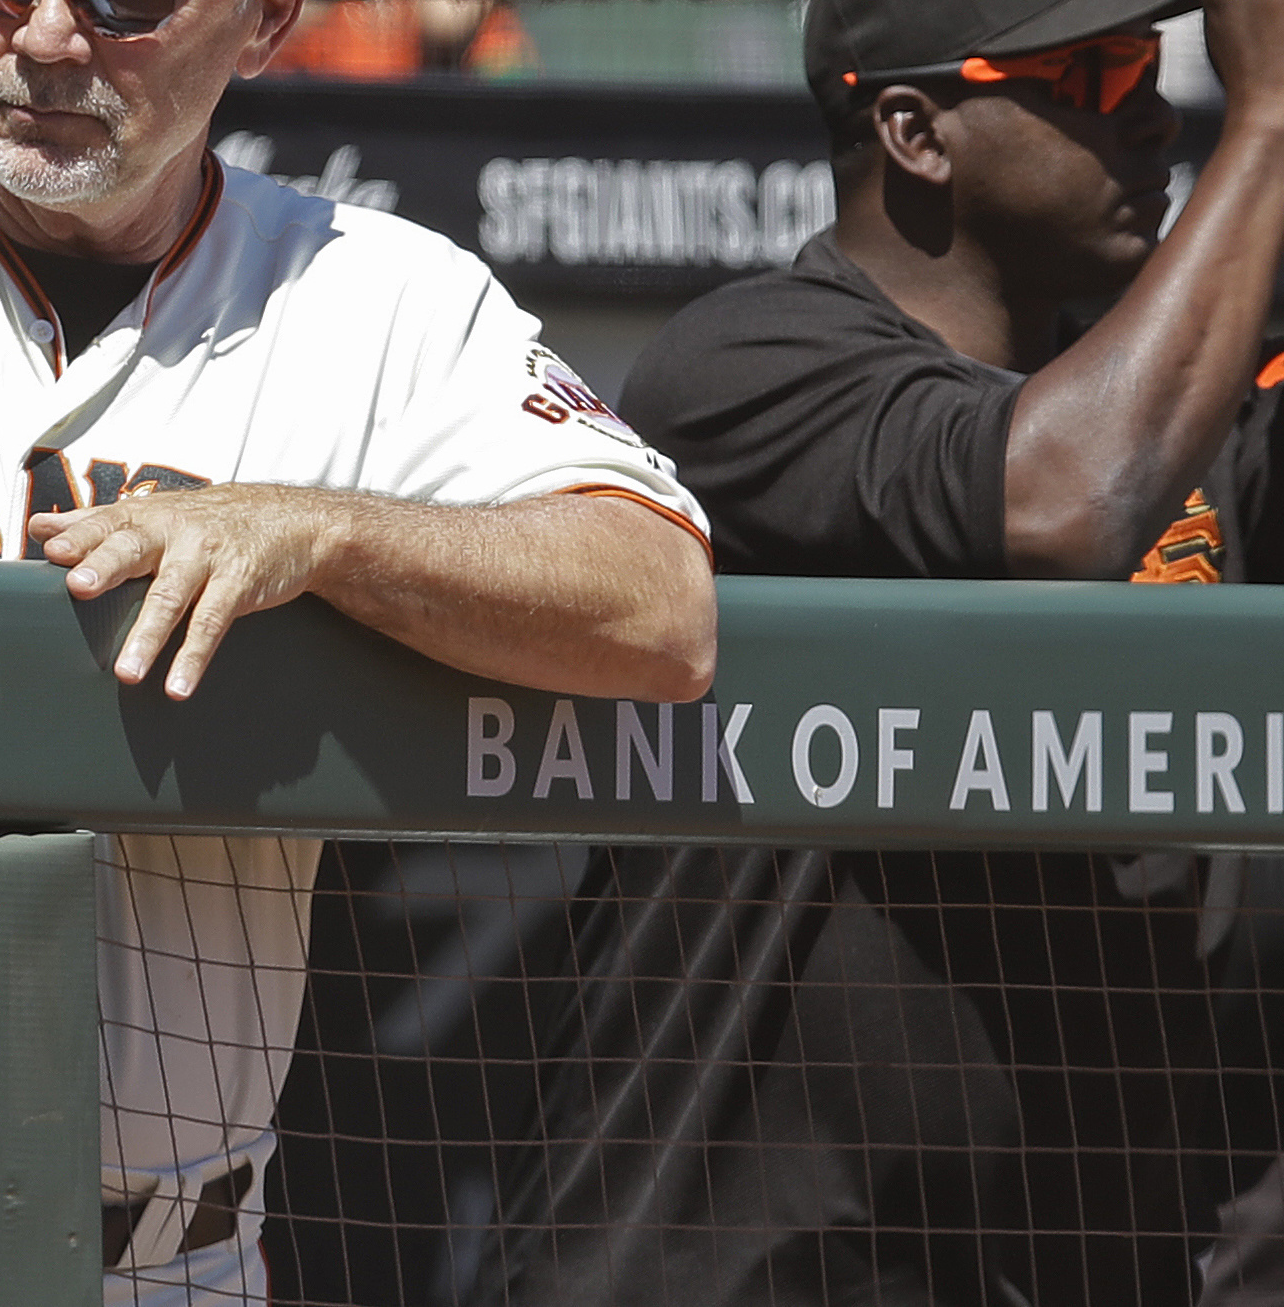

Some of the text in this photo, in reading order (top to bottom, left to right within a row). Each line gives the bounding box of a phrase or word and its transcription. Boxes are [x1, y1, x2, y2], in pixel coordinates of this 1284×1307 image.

[477, 157, 836, 270] SFGIANTS.CO
[466, 696, 756, 805] BANK
[791, 703, 921, 809] OF
